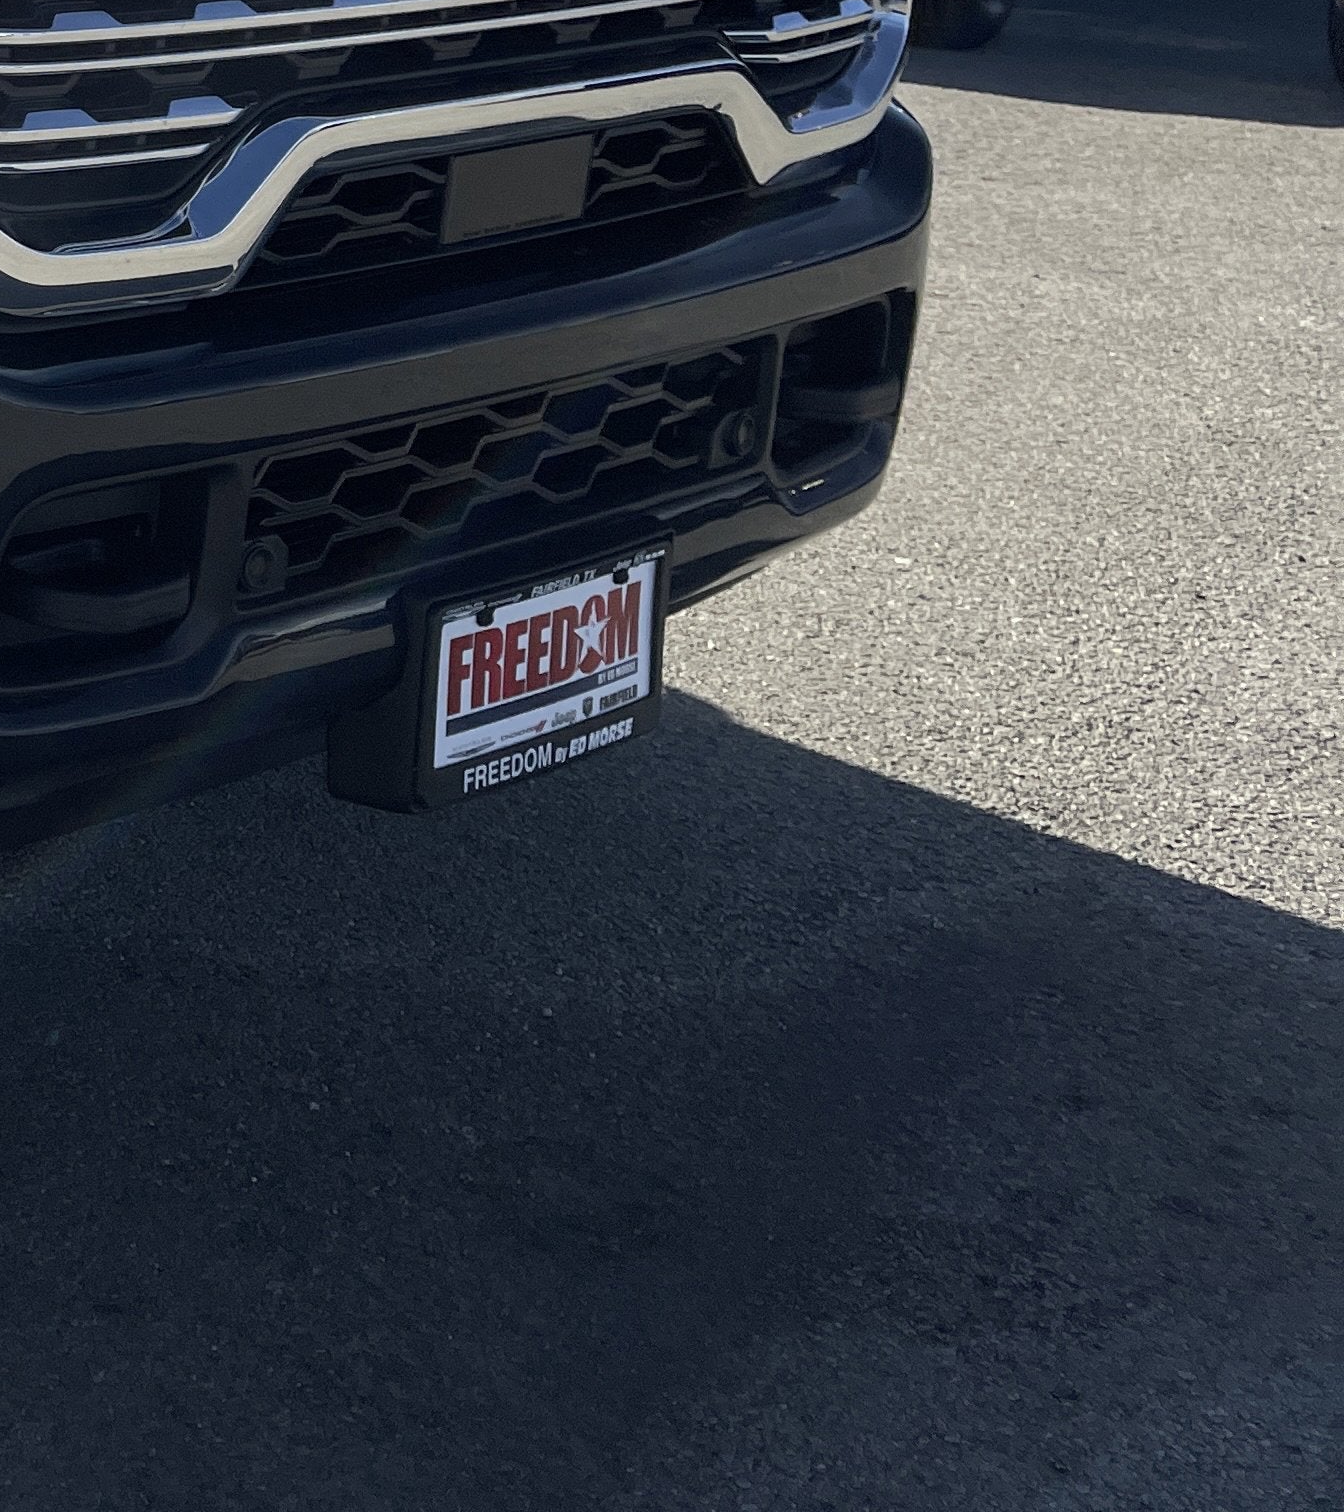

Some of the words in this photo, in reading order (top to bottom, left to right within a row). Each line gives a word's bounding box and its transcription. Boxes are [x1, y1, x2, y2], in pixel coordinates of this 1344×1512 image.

[446, 580, 642, 717] FREEDOM
[463, 742, 553, 794] FREEDOM
[569, 735, 587, 759] ED
[587, 717, 635, 751] MORSE
